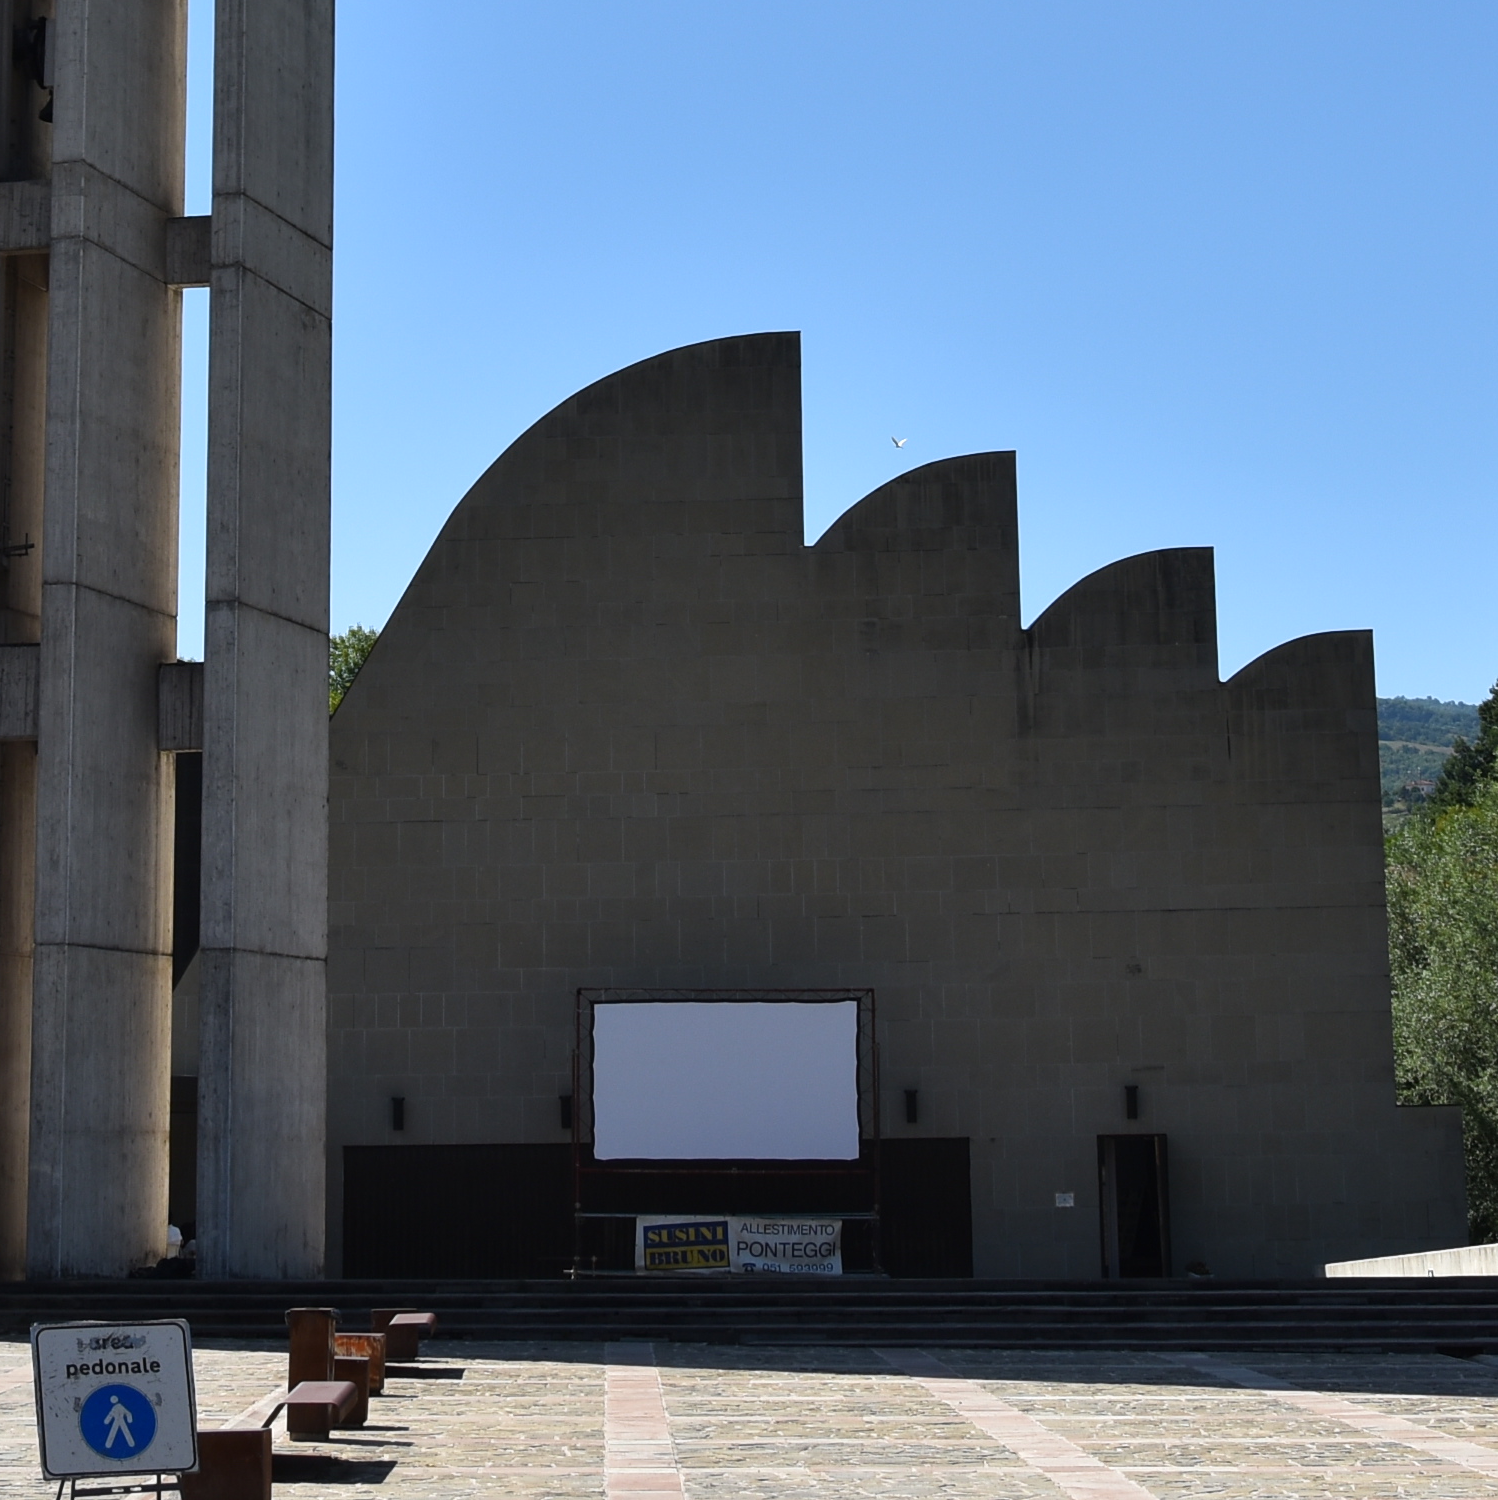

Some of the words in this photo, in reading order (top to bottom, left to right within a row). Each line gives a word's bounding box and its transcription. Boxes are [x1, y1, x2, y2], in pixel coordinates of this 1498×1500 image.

[647, 1226, 725, 1244] SUSINI
[740, 1222, 835, 1236] ALLESTIMENTO
[649, 1248, 726, 1266] BRUNO
[736, 1240, 836, 1258] PONTEGGI
[762, 1262, 782, 1273] 051
[66, 1357, 161, 1379] pedonale
